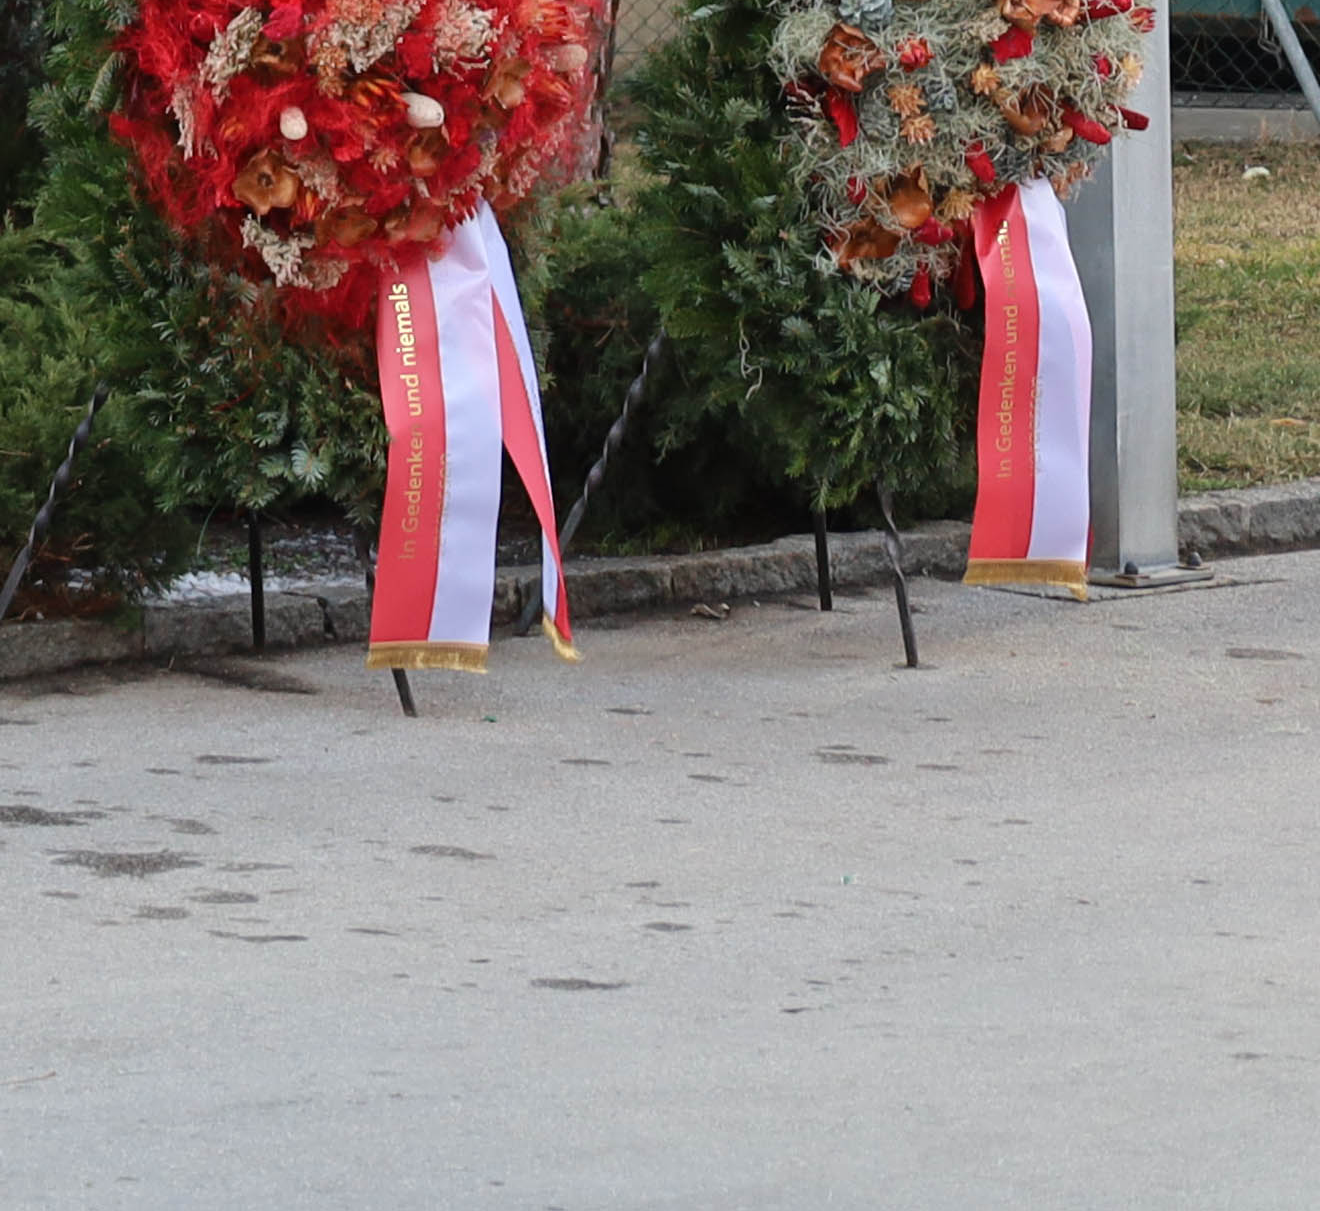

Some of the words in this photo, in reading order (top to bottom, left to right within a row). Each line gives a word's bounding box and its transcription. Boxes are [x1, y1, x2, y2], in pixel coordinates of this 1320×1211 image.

[388, 283, 417, 367] niemals
[1002, 305, 1018, 344] und
[400, 374, 423, 416] und
[996, 350, 1017, 452] Gedenken
[400, 423, 424, 532] Gedenken
[996, 460, 1012, 478] In
[398, 539, 417, 560] In
